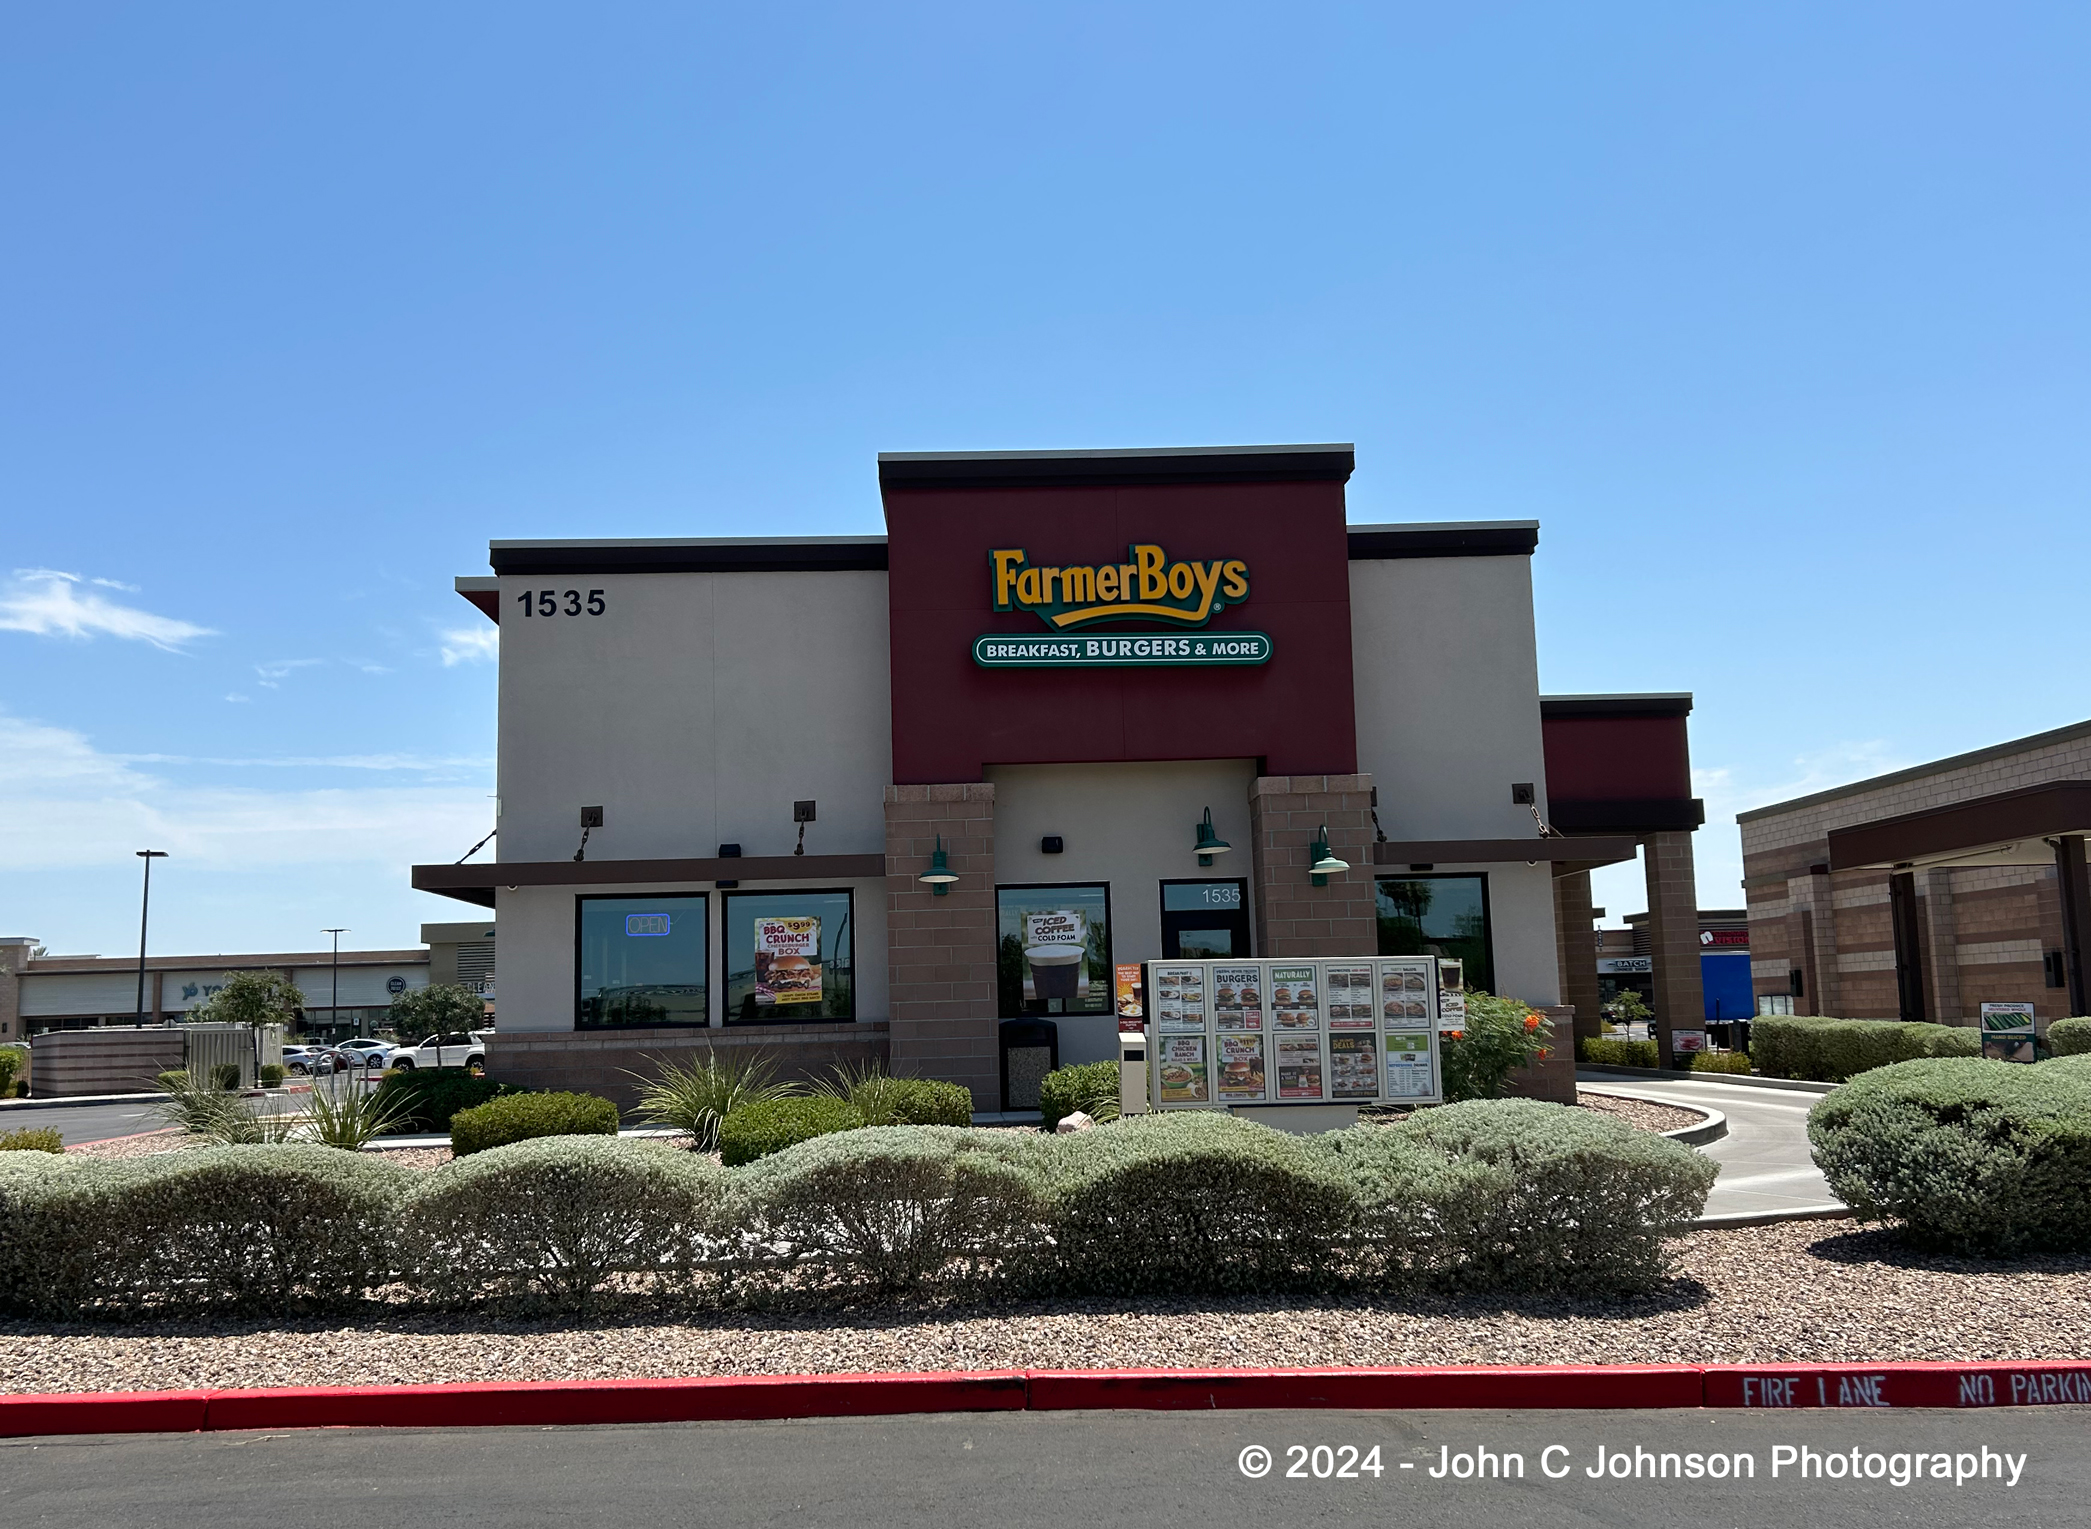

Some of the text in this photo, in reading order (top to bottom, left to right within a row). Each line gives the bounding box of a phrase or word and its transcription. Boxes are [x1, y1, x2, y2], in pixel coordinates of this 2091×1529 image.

[518, 589, 605, 617] 1535
[987, 640, 1259, 659] BREAKFAST, BURGERS & MORE
[1203, 888, 1241, 903] 1535
[629, 917, 667, 933] OPEN
[1043, 916, 1067, 926] ICED
[764, 926, 785, 935] BBQ
[1035, 924, 1075, 935] COFFEE
[766, 933, 809, 944] CRUNCH
[1216, 974, 1258, 983] BURGERS
[1274, 970, 1310, 979] NATURALLY
[1224, 1040, 1239, 1048] BBQ
[1743, 1375, 1890, 1406] FIRE LANE
[1960, 1374, 1994, 1405] NO
